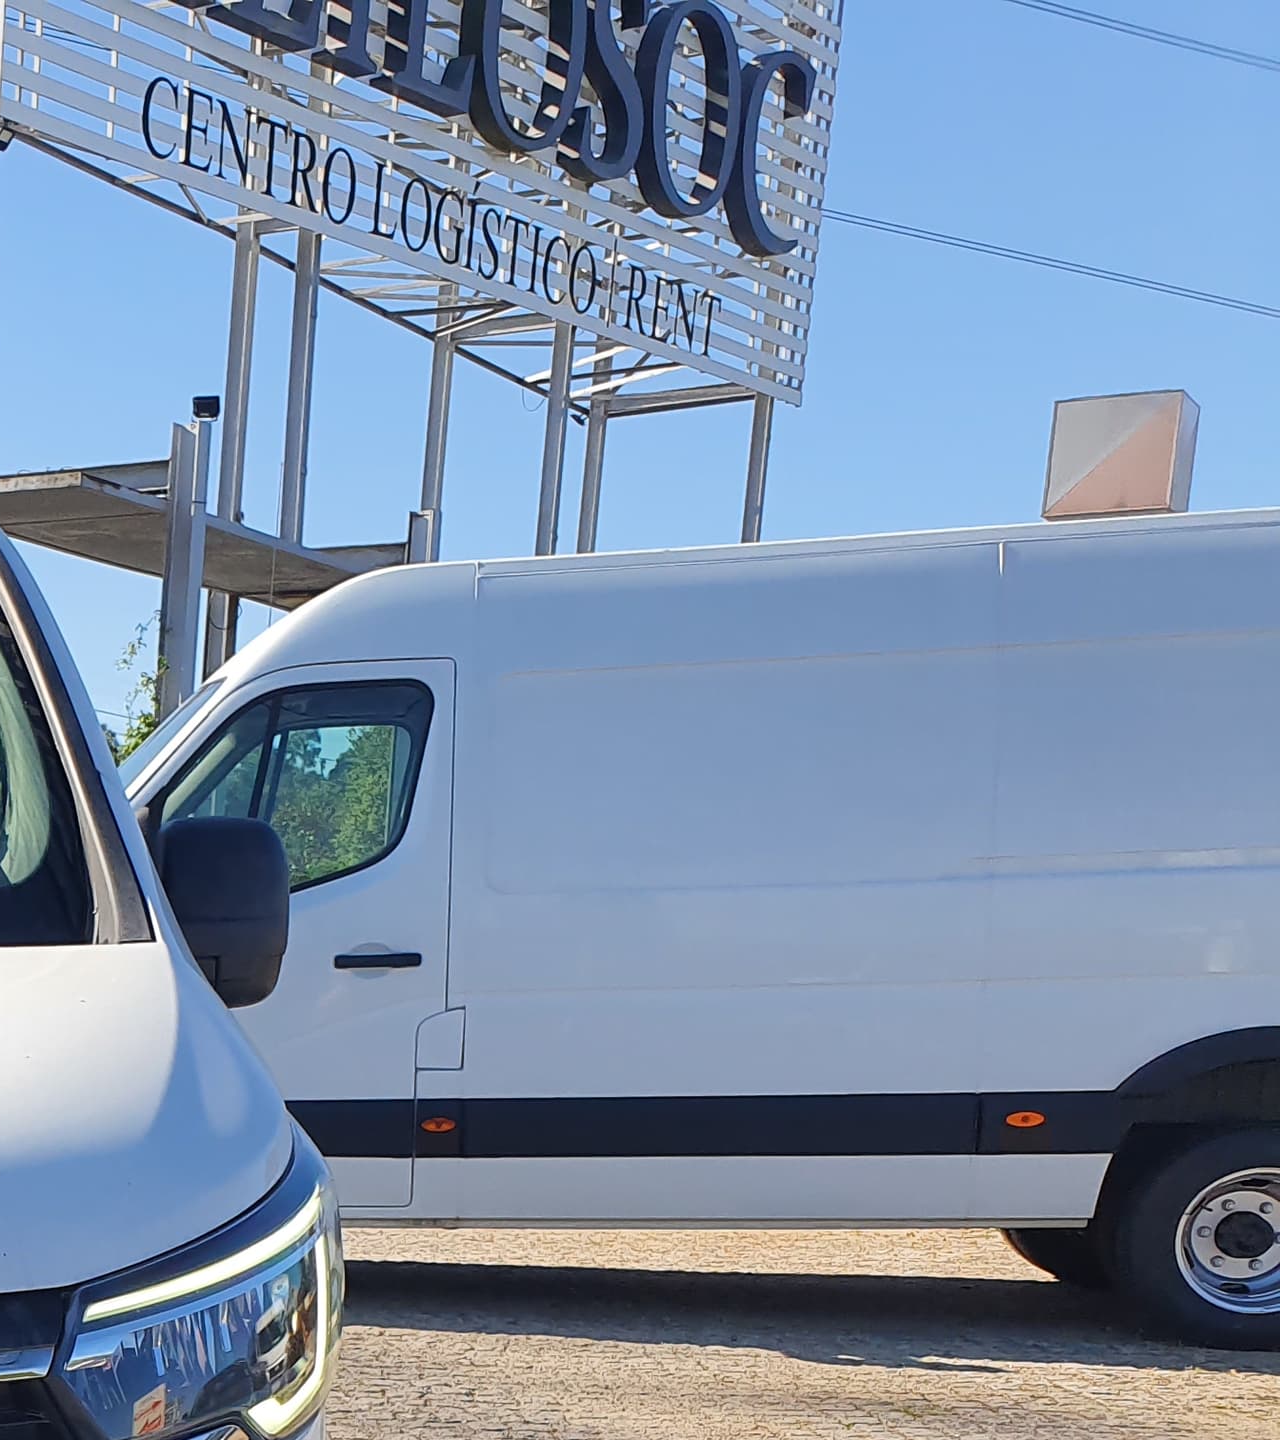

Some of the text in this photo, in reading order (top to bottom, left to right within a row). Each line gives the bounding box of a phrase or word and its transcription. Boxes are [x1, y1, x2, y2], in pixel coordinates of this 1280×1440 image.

[142, 77, 356, 224] CENTRO
[368, 161, 596, 314] LOGÍSTICO
[623, 263, 722, 357] RENT
